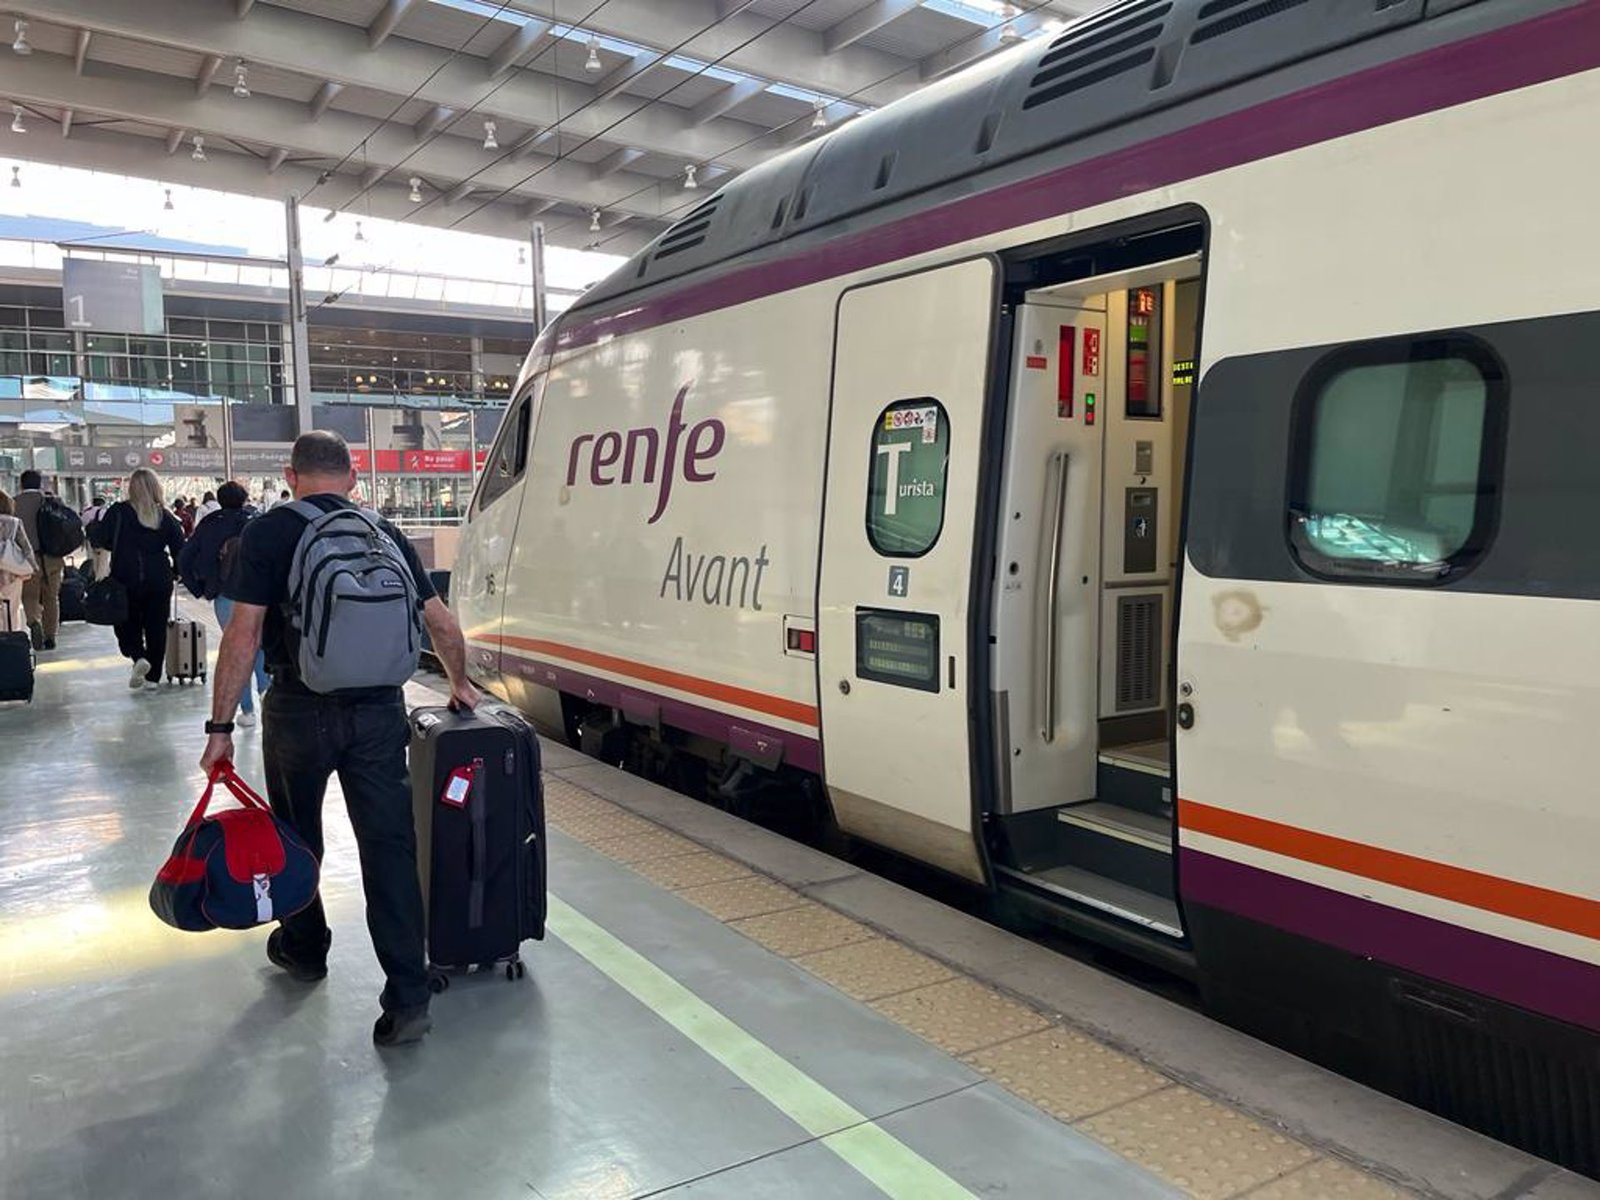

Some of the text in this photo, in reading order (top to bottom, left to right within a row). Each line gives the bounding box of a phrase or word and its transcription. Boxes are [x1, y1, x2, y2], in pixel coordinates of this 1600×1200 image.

[69, 295, 93, 327] 1
[566, 379, 726, 525] renfe
[877, 441, 934, 516] Turista
[660, 536, 769, 611] Avant
[893, 574, 904, 595] 4
